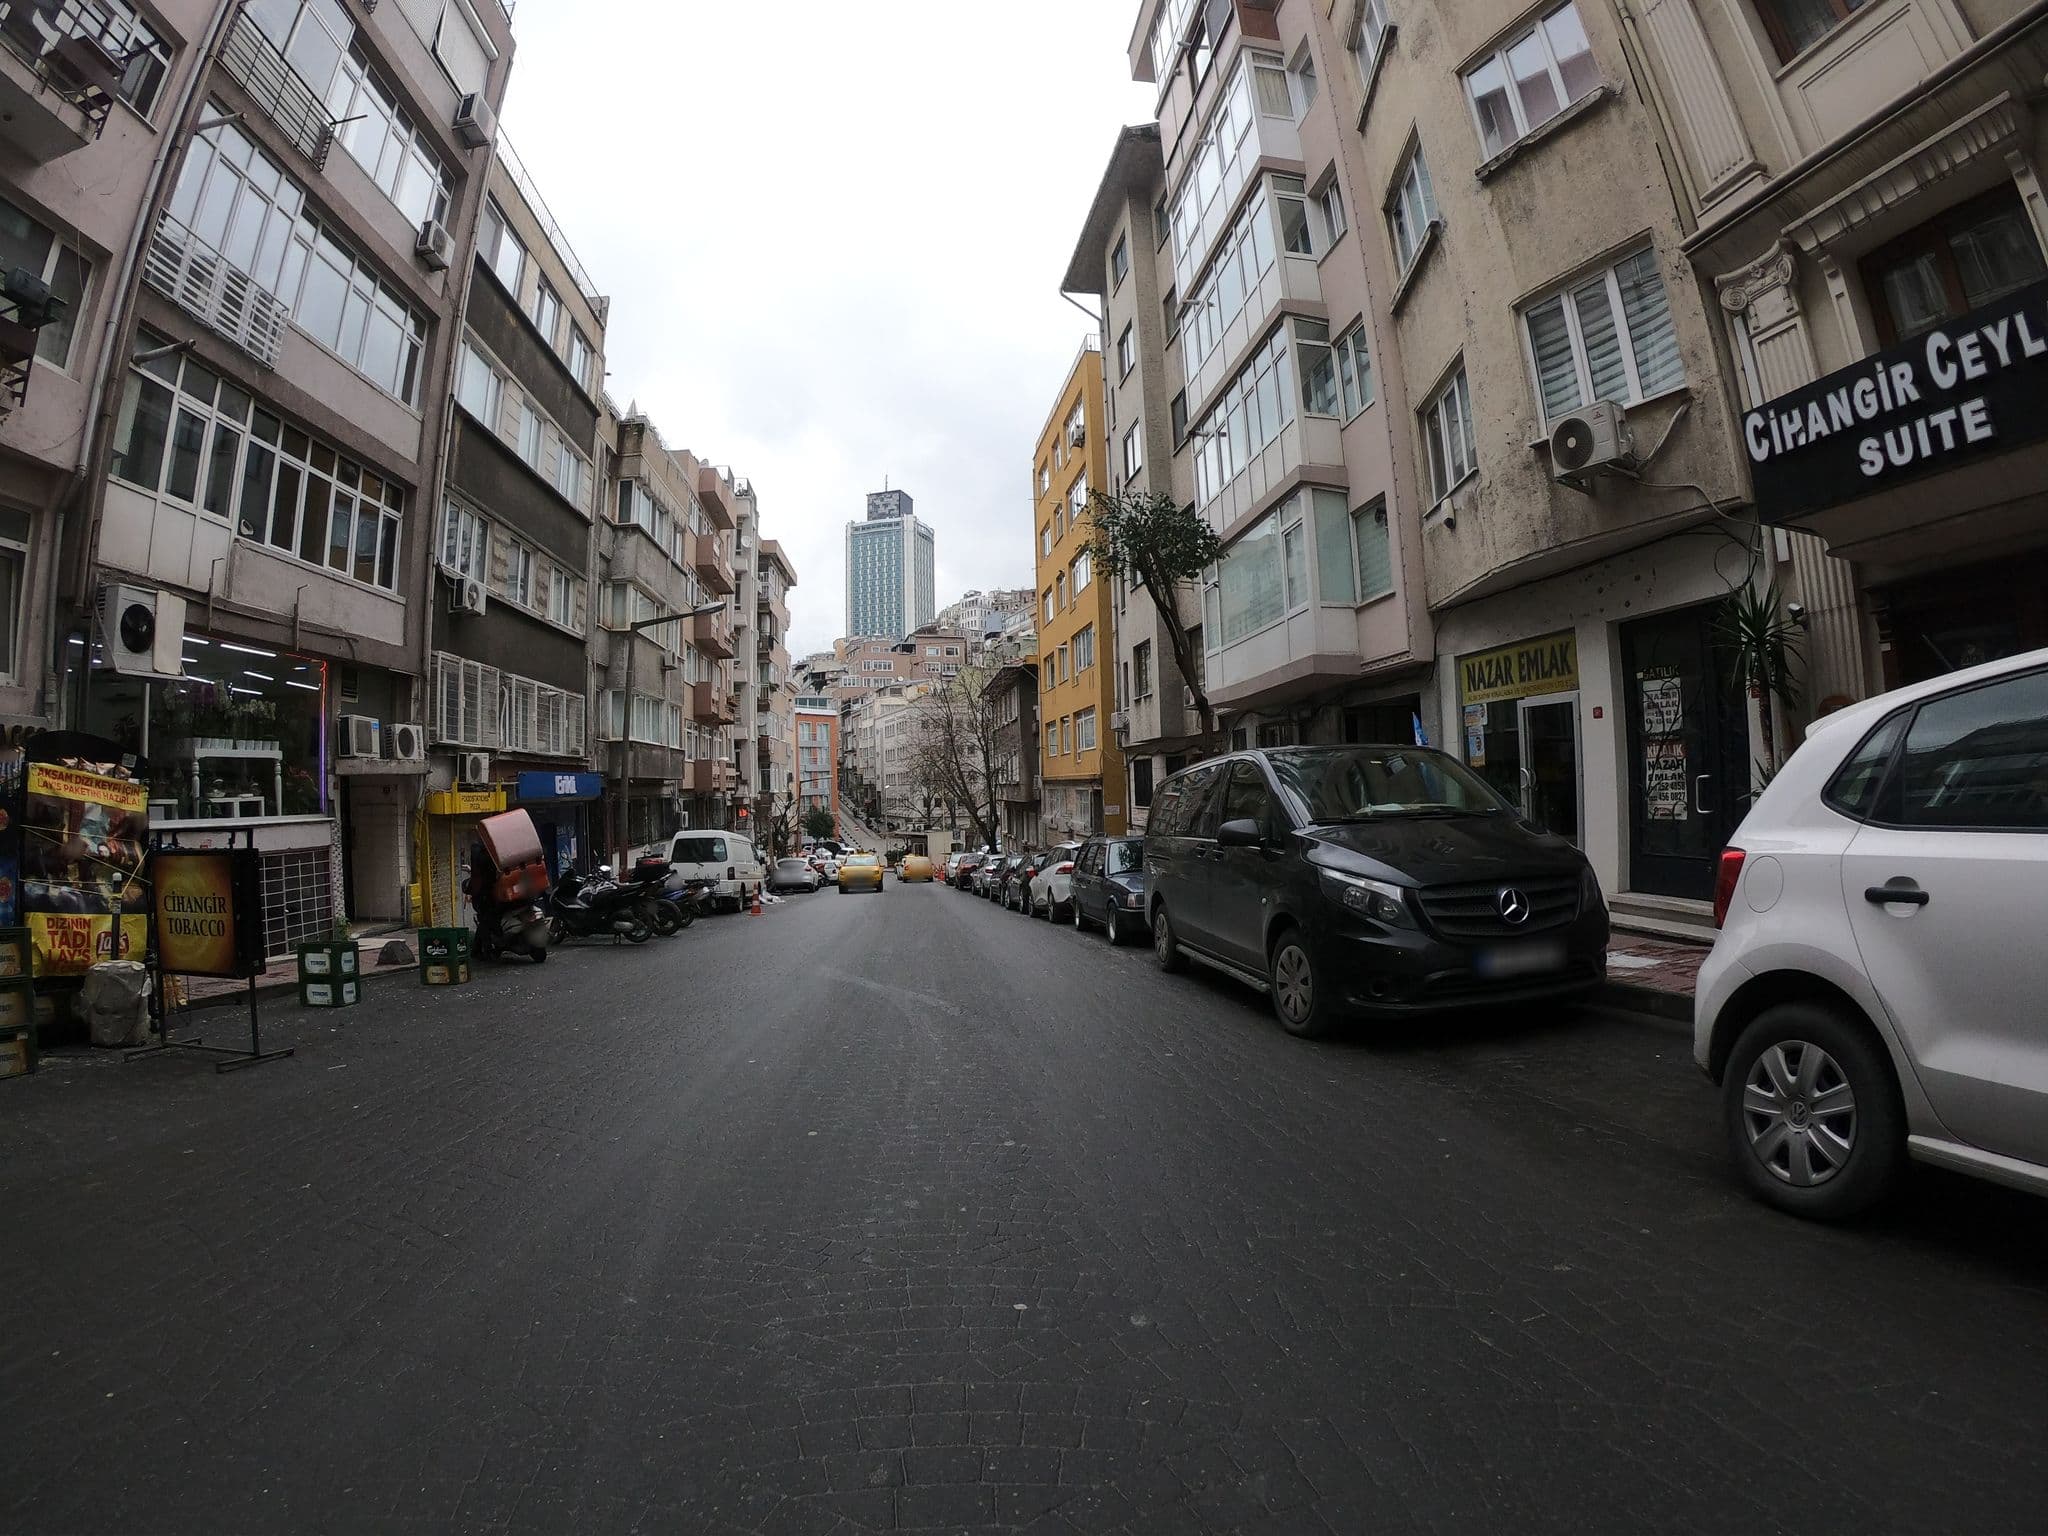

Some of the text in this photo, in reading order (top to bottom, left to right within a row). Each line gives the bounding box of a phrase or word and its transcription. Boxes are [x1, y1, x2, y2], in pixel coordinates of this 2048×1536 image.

[1744, 299, 2048, 464] CİHANGİR CEYL
[1858, 396, 1994, 478] SUITE
[1465, 640, 1573, 693] NAZAR EMLAK
[1648, 758, 1685, 771] NAZAR
[1648, 772, 1684, 782] EMLAK
[163, 890, 228, 914] CİHANGİR
[46, 916, 92, 930] DİZİNİN
[166, 916, 226, 937] TOBACCO
[47, 929, 91, 949] TADI
[47, 948, 91, 963] LAY'S
